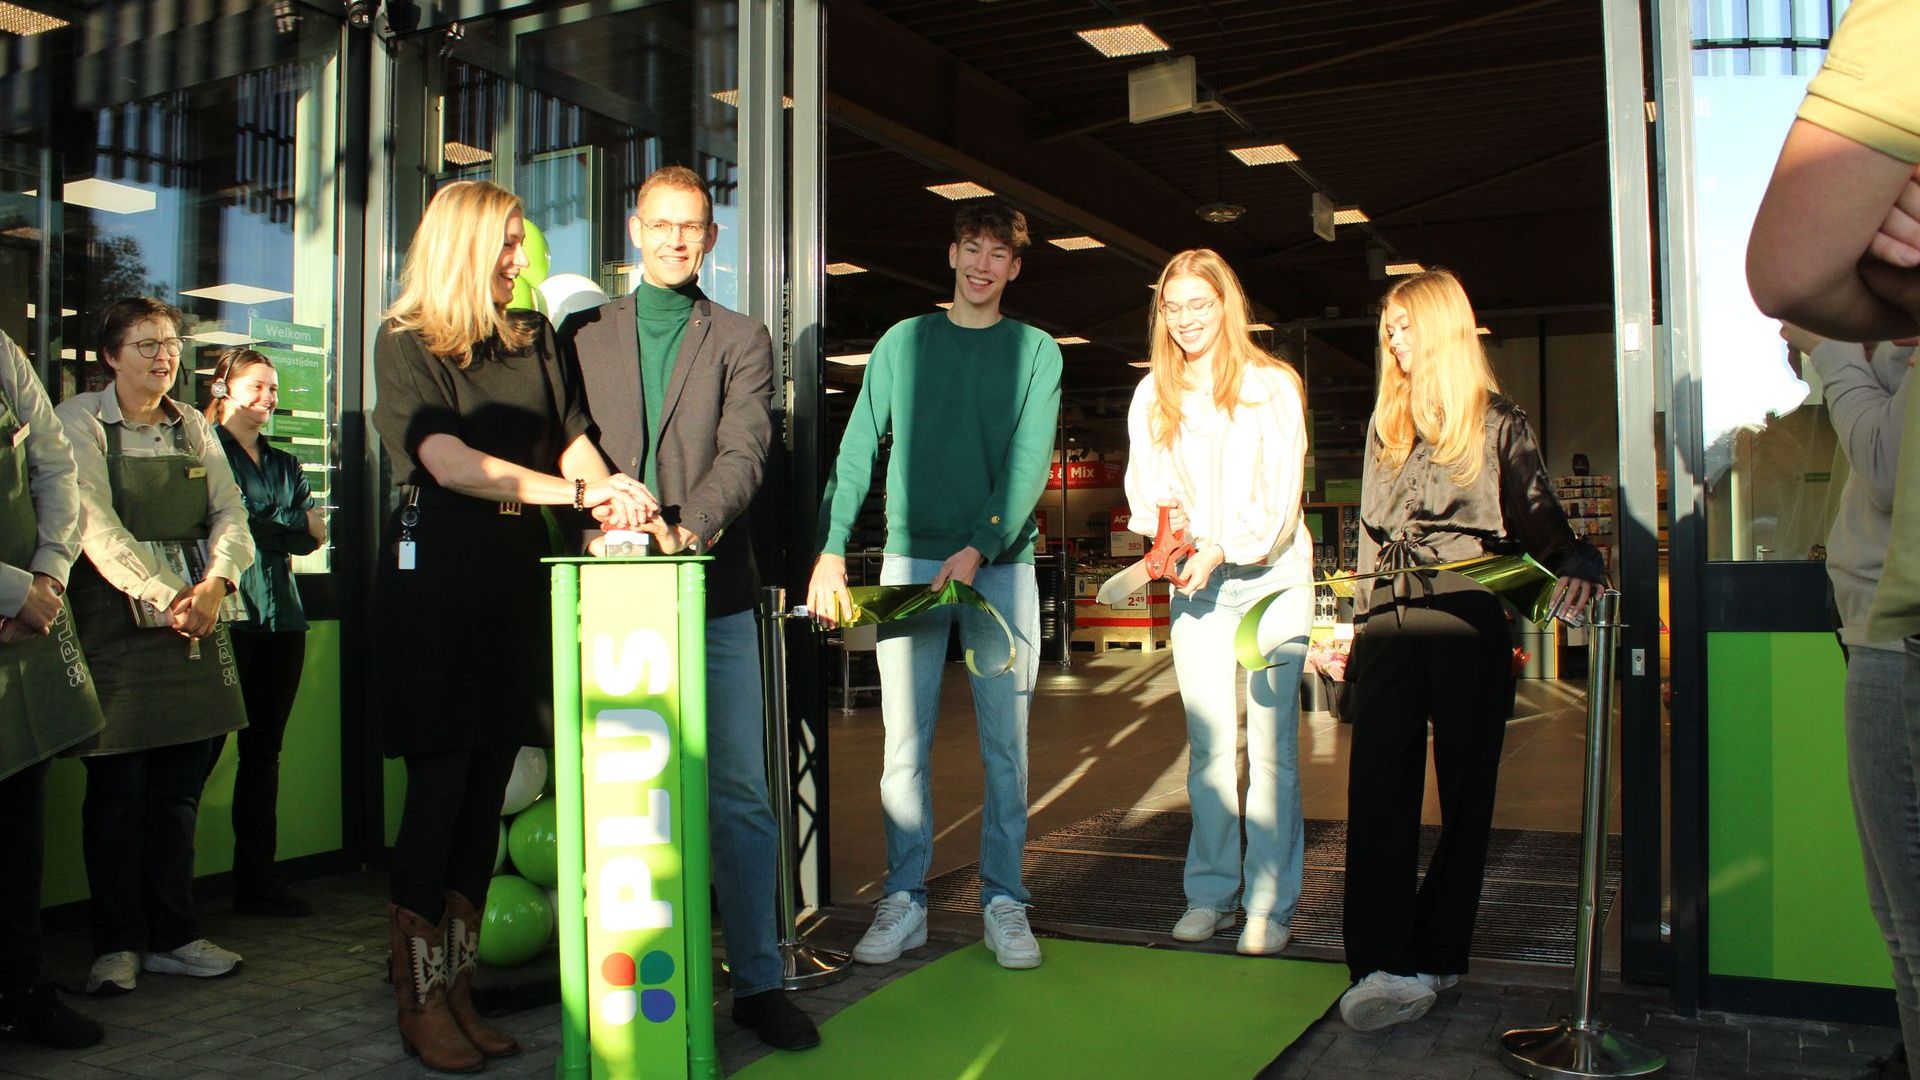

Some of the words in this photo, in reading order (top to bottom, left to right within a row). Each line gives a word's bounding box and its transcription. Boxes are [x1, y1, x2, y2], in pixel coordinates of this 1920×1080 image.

[265, 324, 312, 341] Welkom
[1070, 466, 1095, 479] Mix
[1114, 515, 1130, 523] ACT
[1128, 596, 1145, 607] 2.49
[55, 608, 80, 663] PLU
[592, 628, 673, 929] PLUS
